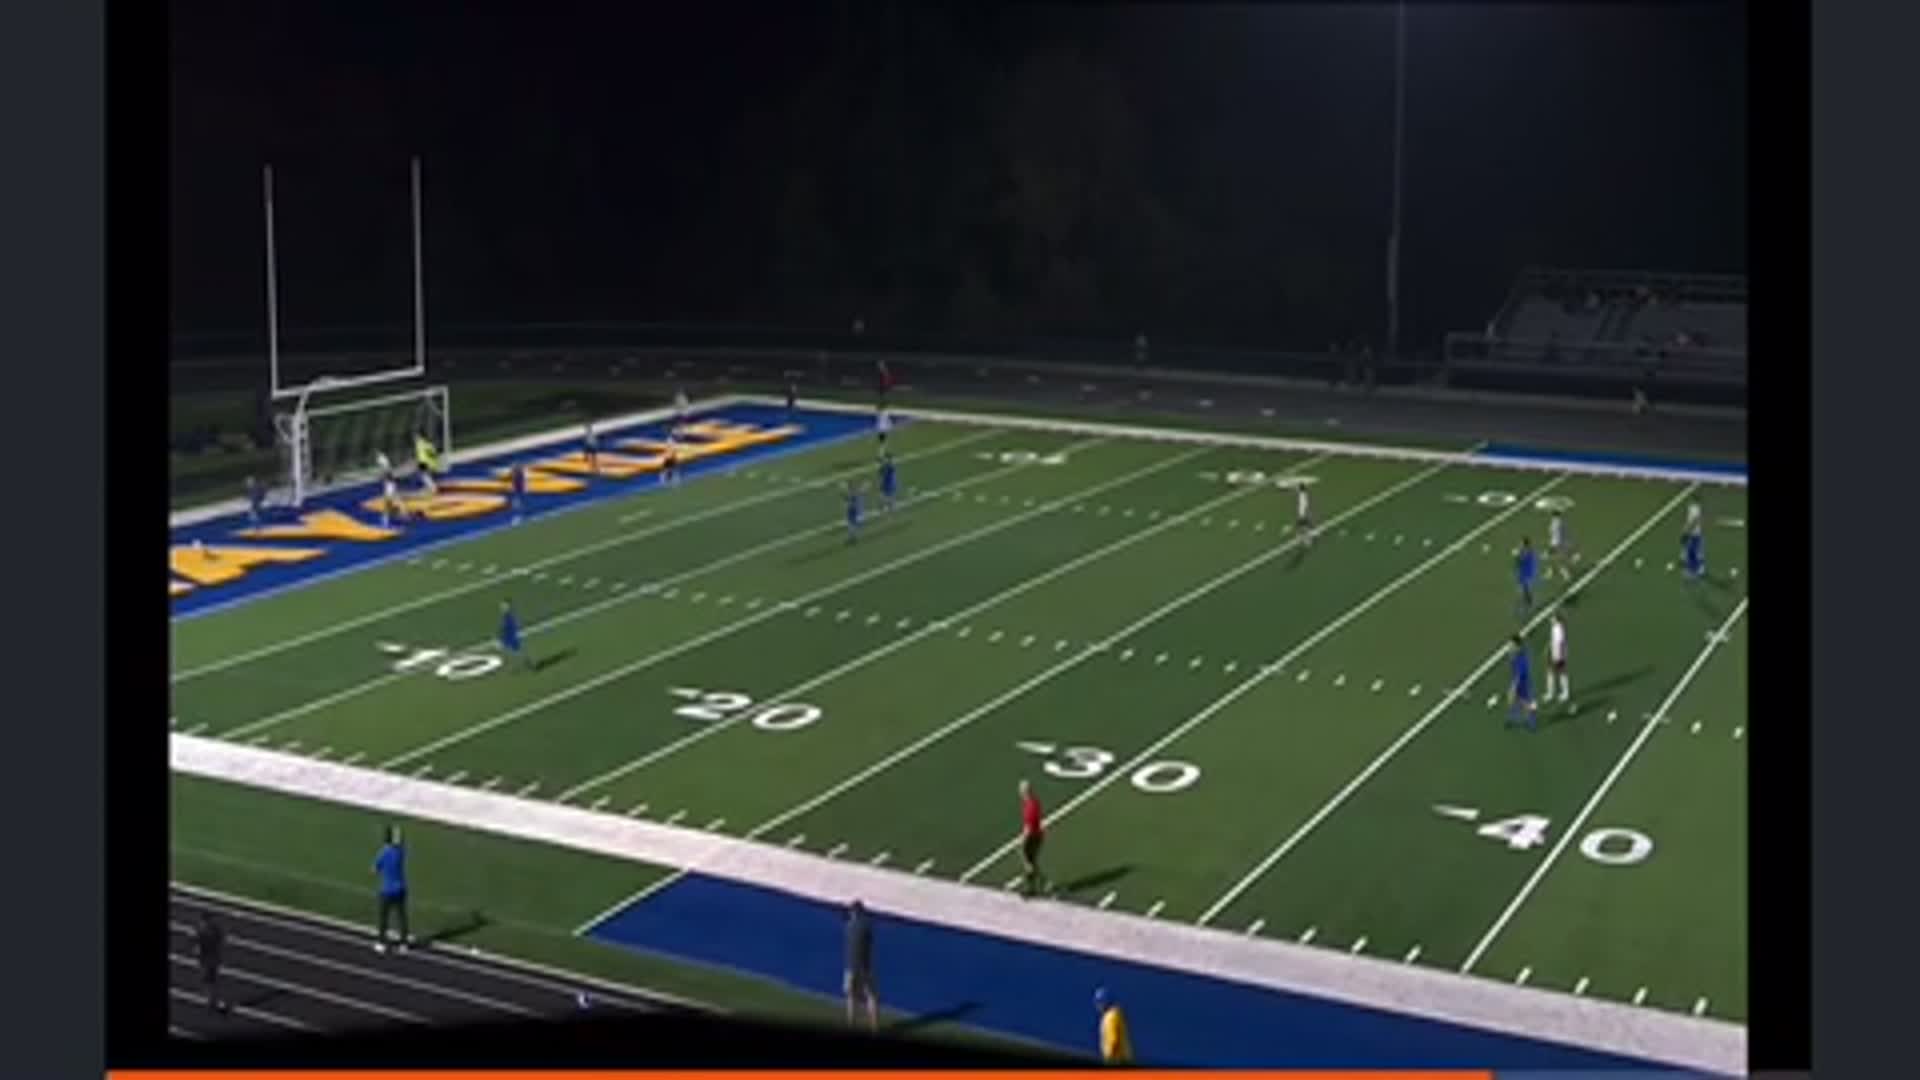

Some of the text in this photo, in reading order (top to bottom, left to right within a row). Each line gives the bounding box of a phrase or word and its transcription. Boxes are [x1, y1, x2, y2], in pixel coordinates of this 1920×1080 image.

[393, 648, 502, 679] 10
[673, 692, 823, 731] 20
[1043, 746, 1200, 793] 30
[1476, 813, 1654, 865] 40
